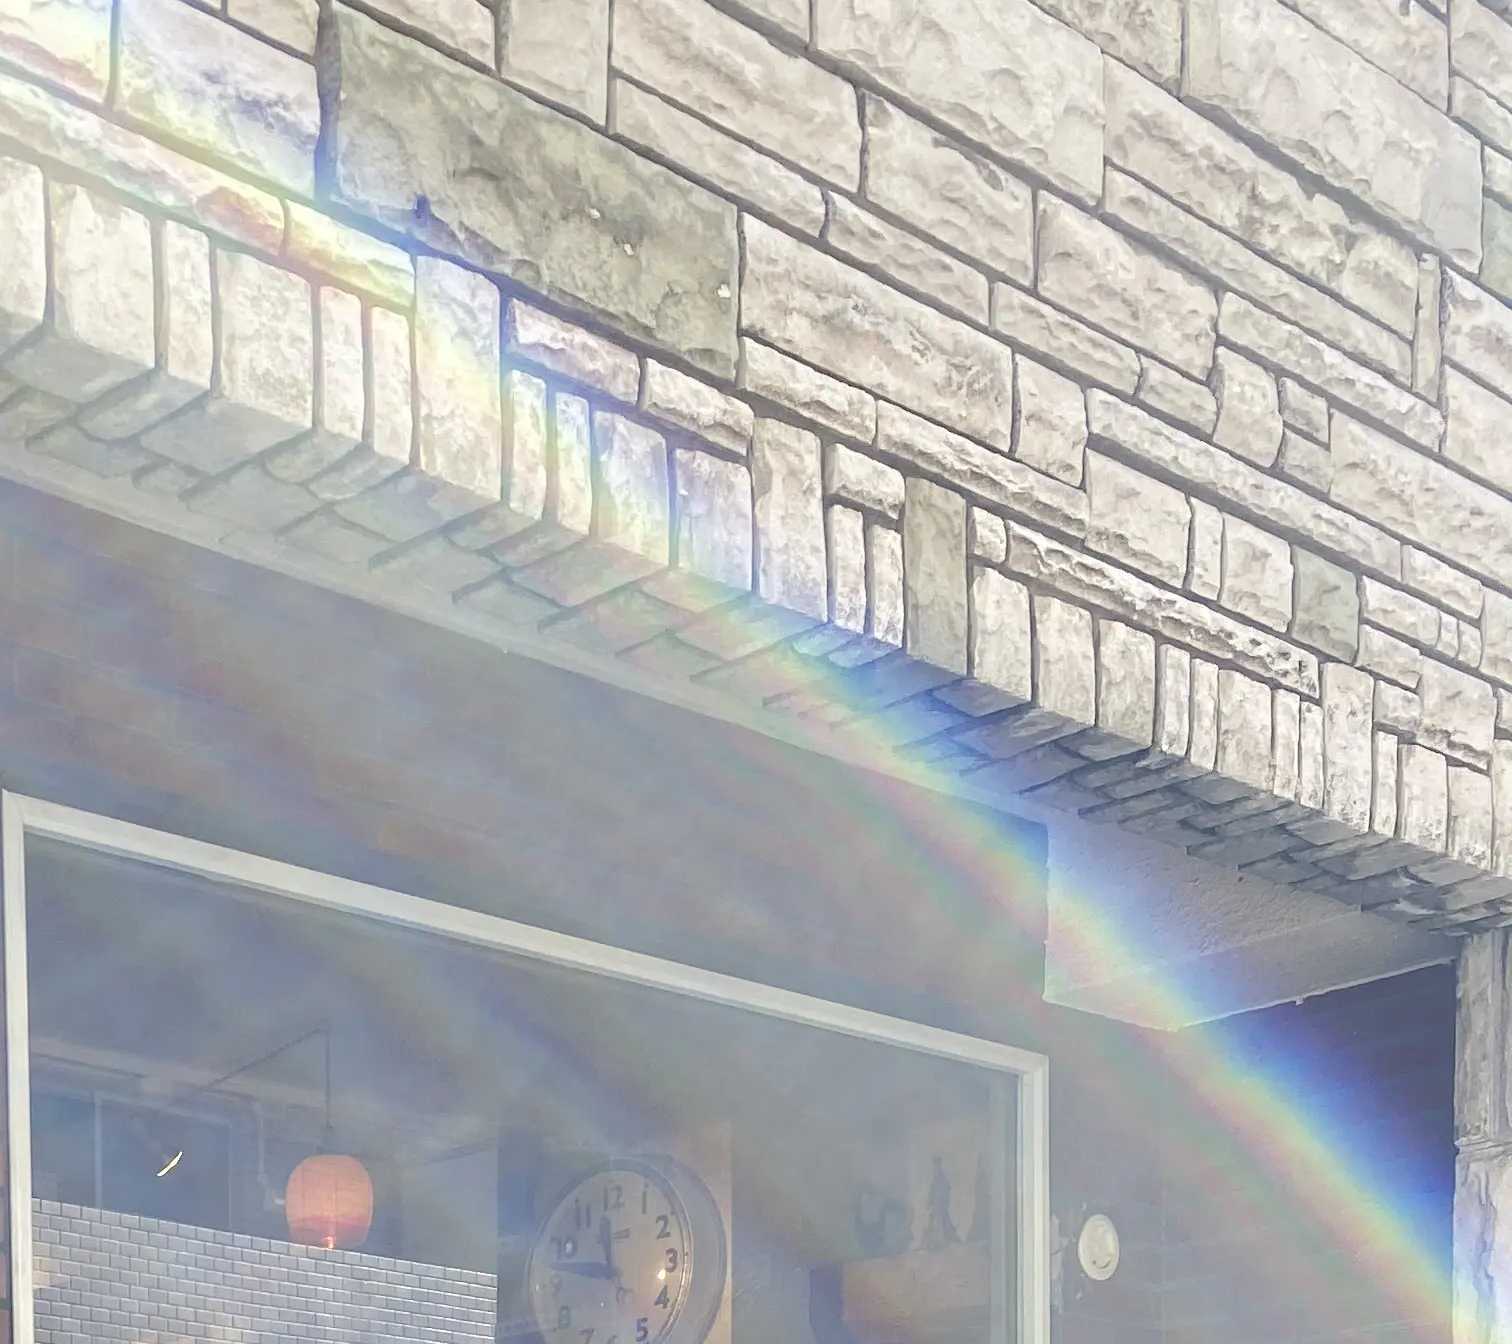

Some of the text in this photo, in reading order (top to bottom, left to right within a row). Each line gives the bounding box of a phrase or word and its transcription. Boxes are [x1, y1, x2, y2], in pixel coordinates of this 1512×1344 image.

[602, 1185, 625, 1212] 12
[575, 1202, 591, 1231] 11
[655, 1214, 670, 1239] 2
[551, 1237, 578, 1259] 10
[665, 1248, 678, 1272] 3
[654, 1285, 669, 1309] 4
[557, 1305, 572, 1330] 8
[635, 1317, 649, 1342] 5
